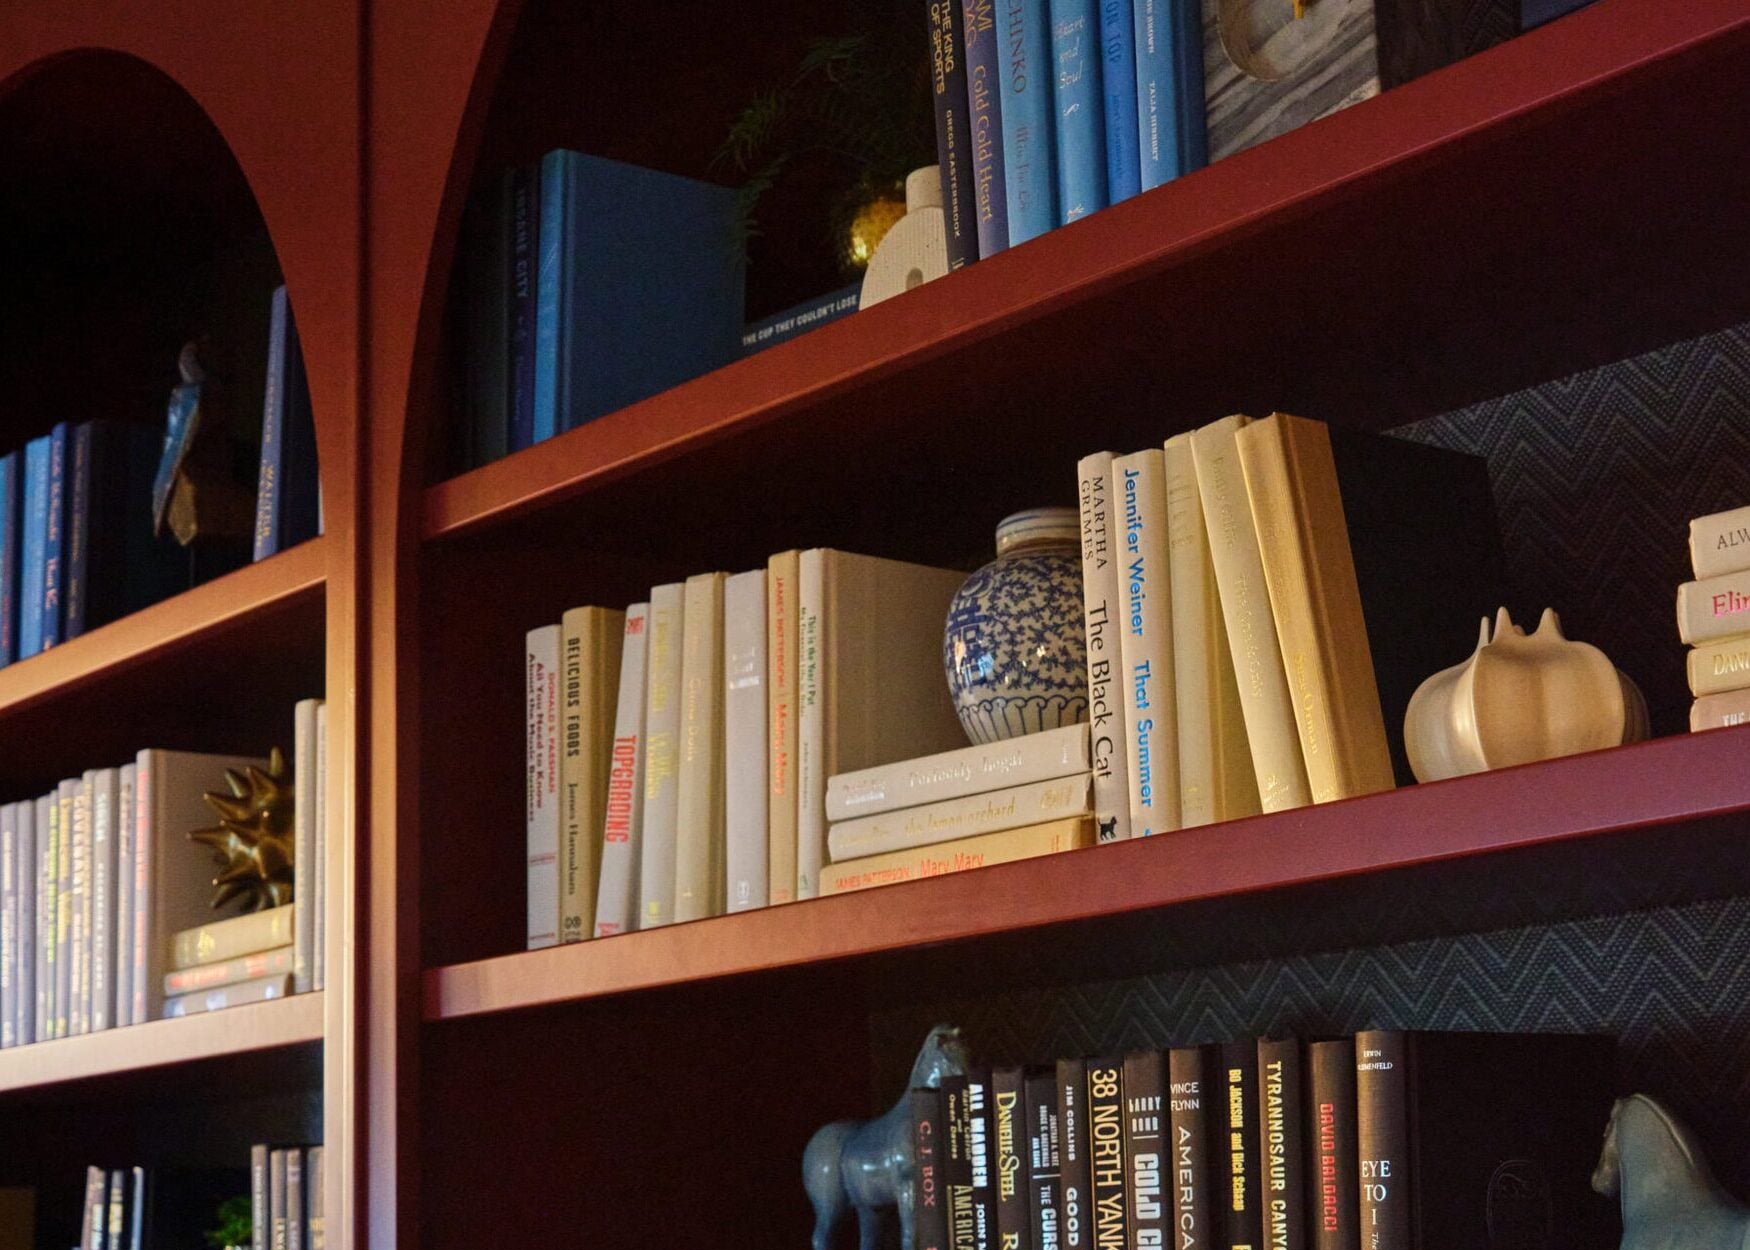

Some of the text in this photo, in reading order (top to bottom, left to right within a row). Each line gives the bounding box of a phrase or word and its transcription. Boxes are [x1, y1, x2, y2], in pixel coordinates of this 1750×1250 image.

[931, 3, 945, 95] OF SPORTS
[942, 0, 954, 73] THE KING
[1108, 34, 1122, 64] TOP
[1060, 60, 1083, 88] Soul
[973, 64, 993, 223] Cold Cold Heart
[949, 152, 960, 237] EASTERBROOK
[758, 326, 774, 340] CUP
[775, 318, 794, 334] THEY
[796, 302, 835, 326] COULDN'T
[836, 295, 858, 310] LOSE
[1081, 480, 1093, 561] GRIMES
[1092, 476, 1107, 569] MARTHA
[1124, 469, 1146, 636] Jennifer Weiner
[776, 576, 785, 688] JAMES PATTERSON
[807, 616, 816, 633] This
[807, 664, 816, 681] Year
[808, 647, 816, 661] the
[548, 672, 556, 723] DONALD
[567, 638, 580, 757] DELICIOUS FOODS
[807, 691, 816, 706] Put
[1089, 601, 1113, 780] The Black Cat
[1133, 660, 1153, 807] That Summer
[1299, 693, 1320, 755] Orman
[1722, 712, 1744, 727] THE
[537, 754, 544, 766] to
[774, 753, 788, 796] Mary
[568, 783, 578, 820] James
[606, 735, 637, 843] TOPGRADING
[954, 851, 985, 871] Mary
[962, 1089, 971, 1122] Marvin
[1092, 1068, 1118, 1098] 38
[1170, 1082, 1199, 1094] VINCE
[1170, 1098, 1200, 1111] FLYNN
[948, 1093, 958, 1160] Owen Davies
[969, 1084, 988, 1188] ALL MADDEN
[1039, 1105, 1048, 1125] BRUCE
[1049, 1114, 1058, 1144] JONATHAN
[1065, 1085, 1076, 1161] JIM COLLINS
[1266, 1061, 1286, 1191] TYRANNOSAUR
[920, 1120, 935, 1207] C. J. BOX
[996, 1091, 1020, 1202] DANIELLE STEEL
[1041, 1133, 1050, 1168] GREENWALD
[1093, 1104, 1122, 1187] NORTH
[1228, 1068, 1246, 1212] BO JACKSON and Dick Schaap
[1134, 1153, 1161, 1220] COLD
[1320, 1103, 1337, 1232] DAVID BALDACCI
[1361, 1160, 1391, 1178] EYE
[1040, 1185, 1052, 1205] THE
[1066, 1187, 1079, 1246] GOOD
[1364, 1184, 1387, 1201] TO
[1371, 1208, 1377, 1225] I
[975, 1203, 986, 1239] JOHN
[1371, 1231, 1380, 1250] The
